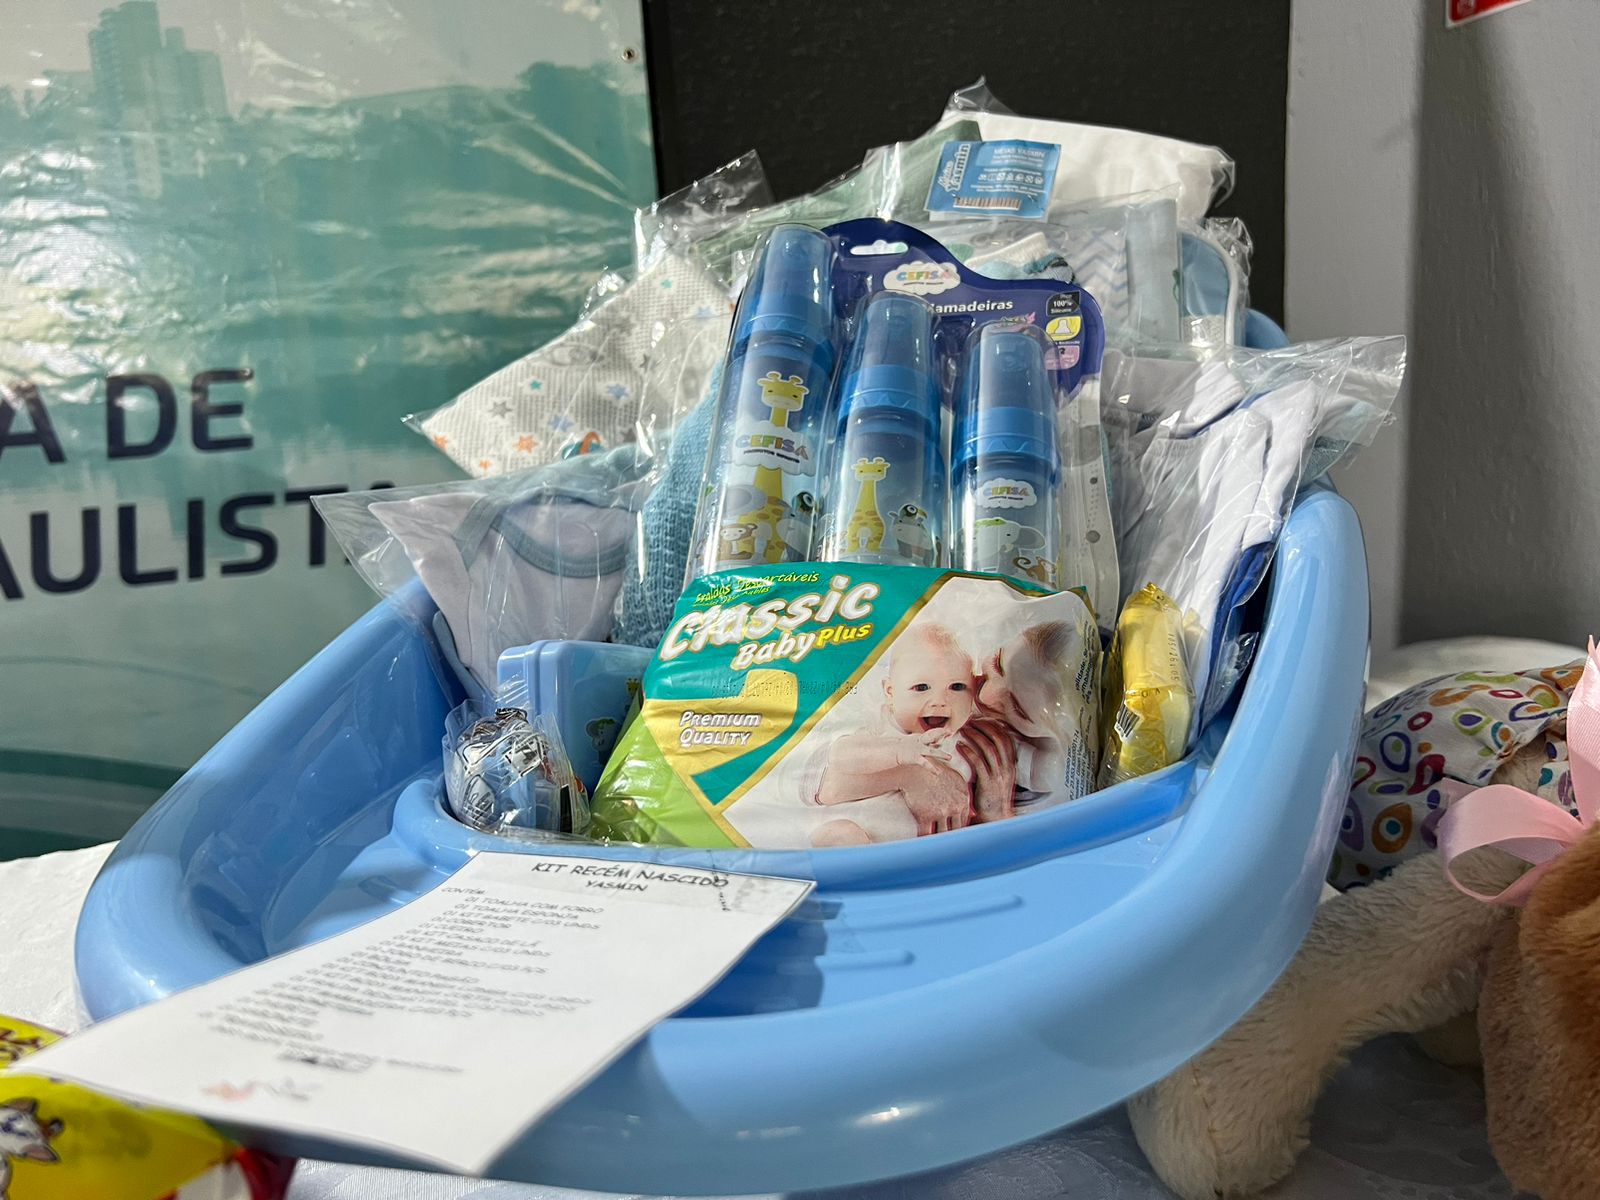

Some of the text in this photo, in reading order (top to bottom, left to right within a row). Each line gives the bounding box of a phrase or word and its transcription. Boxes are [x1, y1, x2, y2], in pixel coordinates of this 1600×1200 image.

[896, 268, 952, 281] CEFISA
[106, 368, 254, 459] DE
[0, 481, 397, 601] ULIST
[730, 623, 873, 670] Baby Plus
[531, 862, 729, 889] KIT RECÉM NASCIDO
[585, 880, 648, 892] YASMIN
